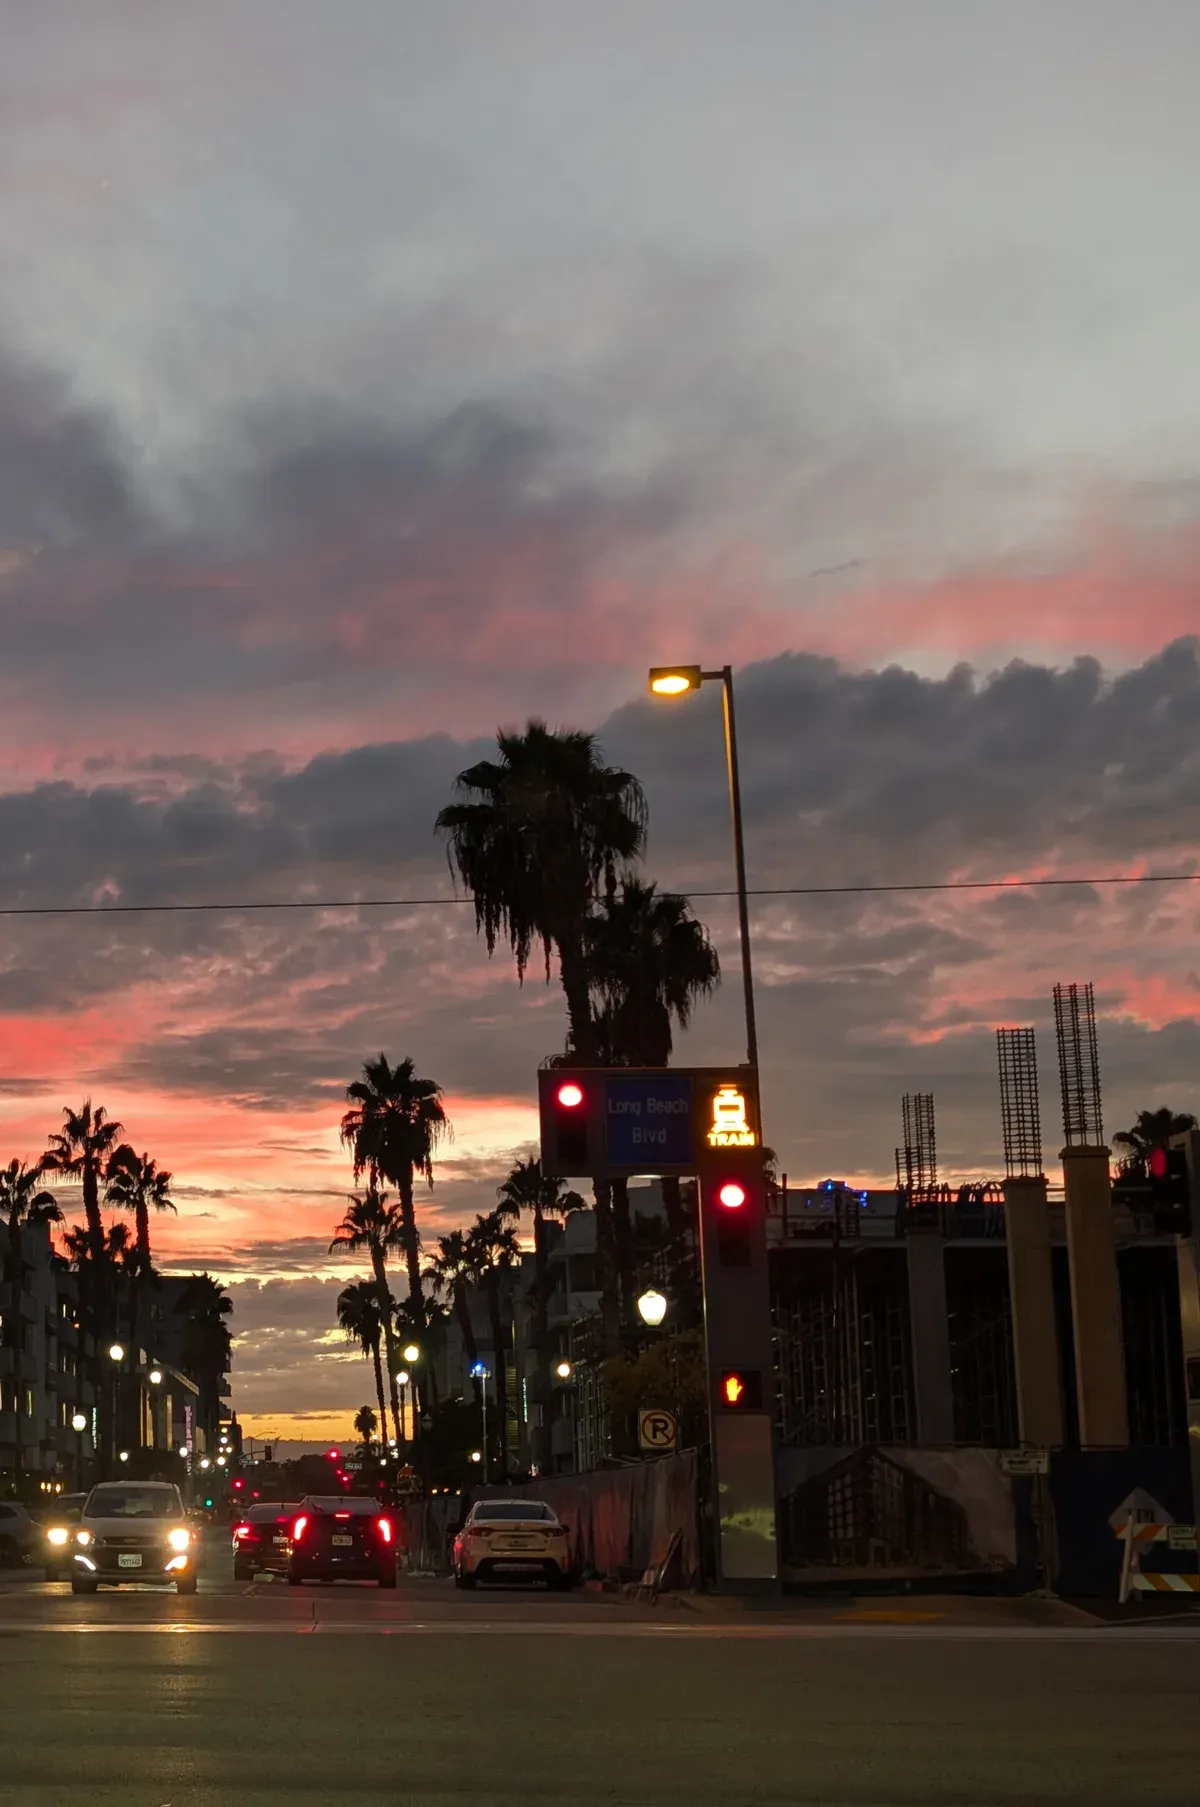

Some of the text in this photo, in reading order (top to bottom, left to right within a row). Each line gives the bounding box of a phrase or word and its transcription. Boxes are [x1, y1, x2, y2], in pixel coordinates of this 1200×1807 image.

[608, 1098, 688, 1116] Long Beach
[632, 1127, 667, 1144] Blvd
[707, 1132, 755, 1146] TRAIN
